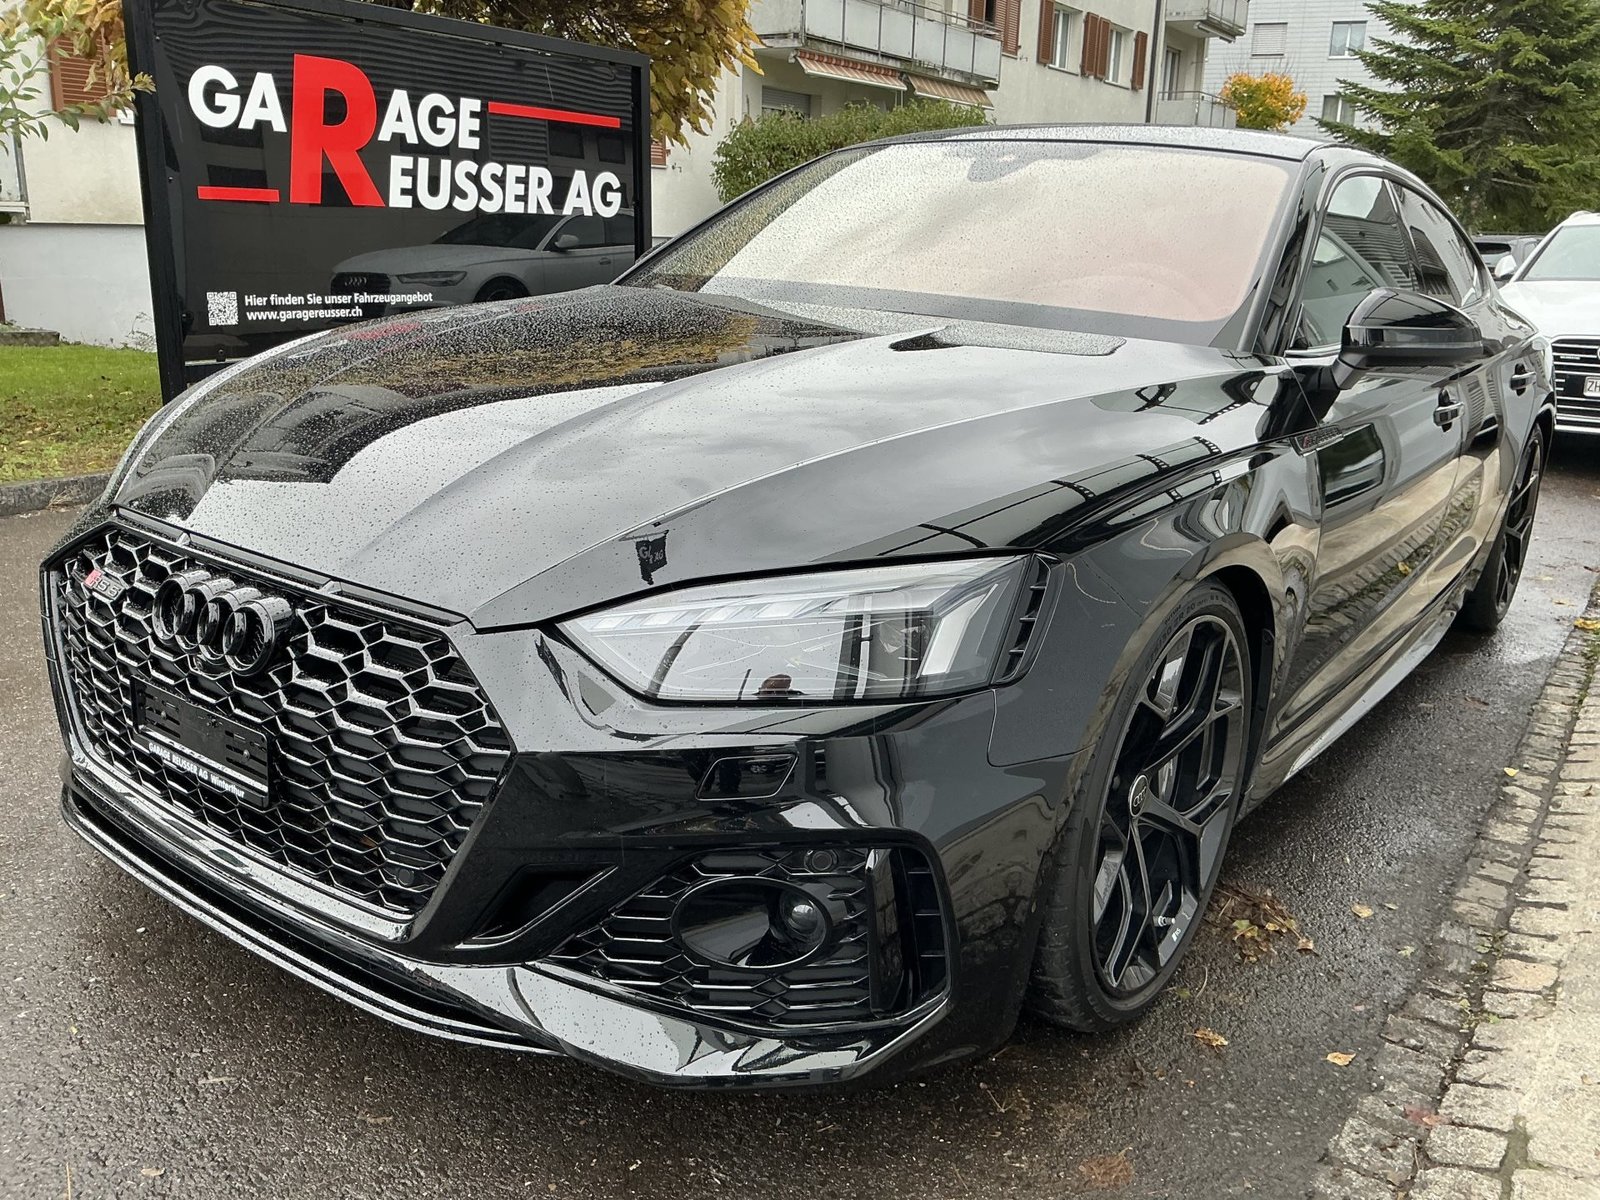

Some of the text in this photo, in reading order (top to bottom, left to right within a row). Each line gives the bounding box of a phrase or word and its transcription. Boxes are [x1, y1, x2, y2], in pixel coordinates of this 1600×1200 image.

[188, 53, 482, 207] GARAGE
[562, 170, 622, 218] AG
[244, 291, 433, 306] Hier finden Sie unser Fahrzeugangebot
[246, 306, 363, 322] www.garagereusser.ch
[198, 768, 209, 780] AG
[210, 773, 245, 798] Winterthur
